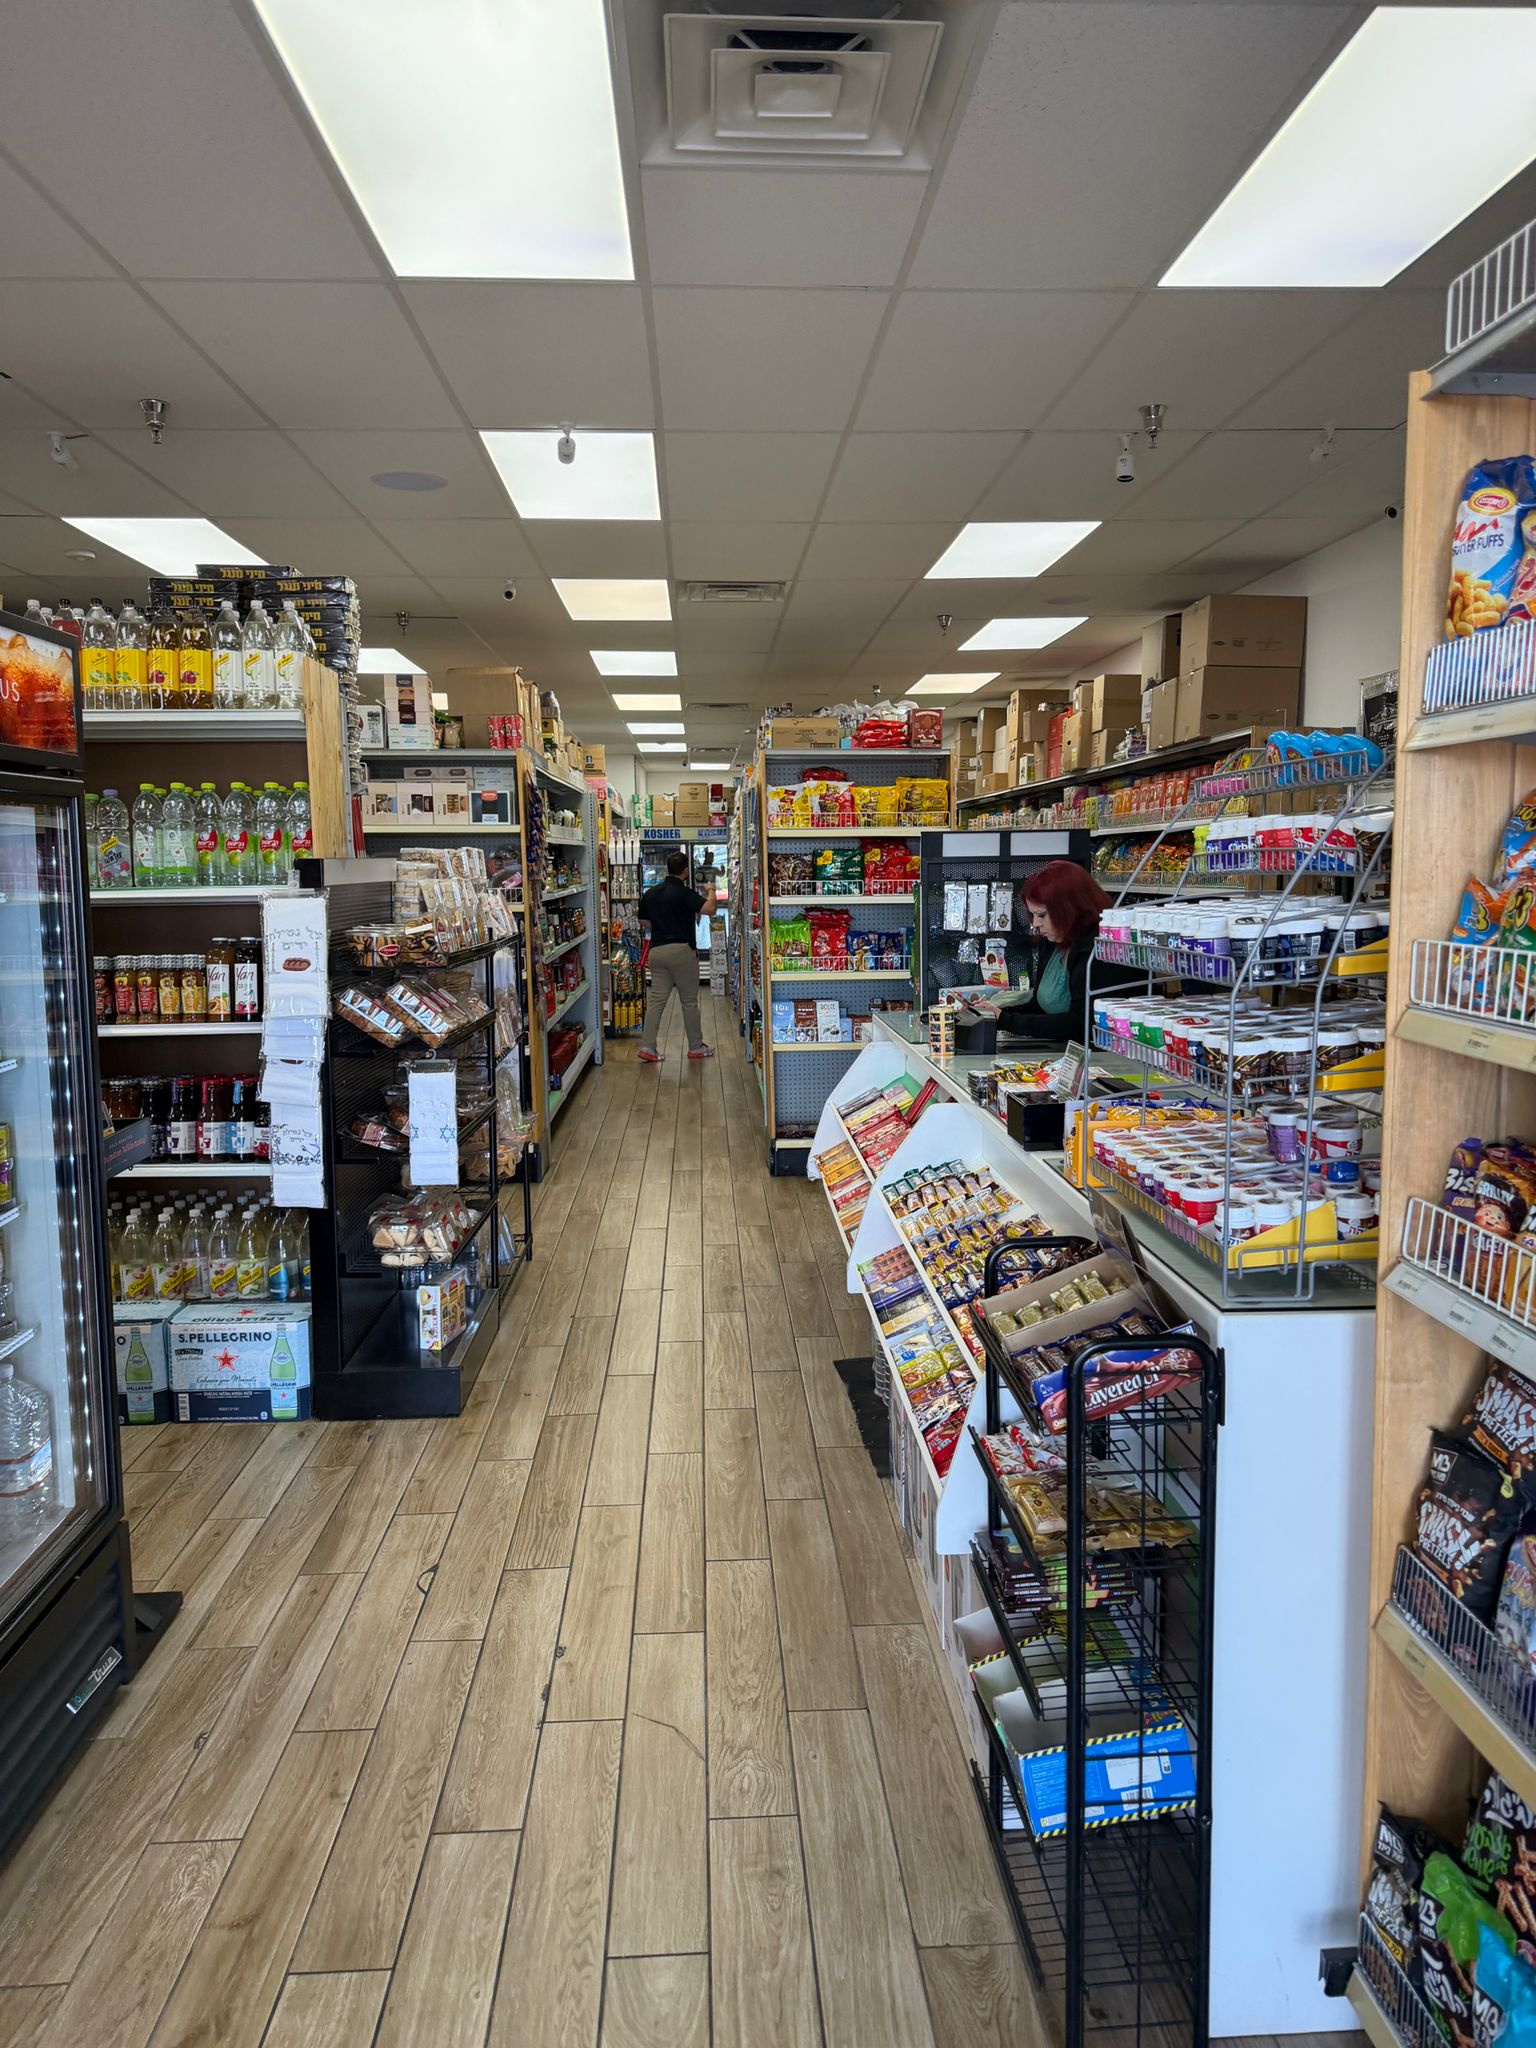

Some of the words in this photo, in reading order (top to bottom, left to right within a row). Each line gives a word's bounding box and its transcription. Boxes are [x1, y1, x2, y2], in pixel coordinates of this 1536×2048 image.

[1476, 534, 1504, 550] PUFFS
[644, 829, 681, 839] KOSHER
[697, 828, 728, 837] KOSHE
[207, 965, 226, 982] Yan
[236, 966, 254, 984] Yan
[1445, 1167, 1475, 1192] Bis
[178, 1331, 272, 1344] S.PELLEGRINO
[1084, 1372, 1142, 1408] Layered
[1480, 1409, 1521, 1452] PRETZELS
[1419, 1501, 1481, 1571] SMASH
[1418, 1535, 1452, 1569] PRETZELS
